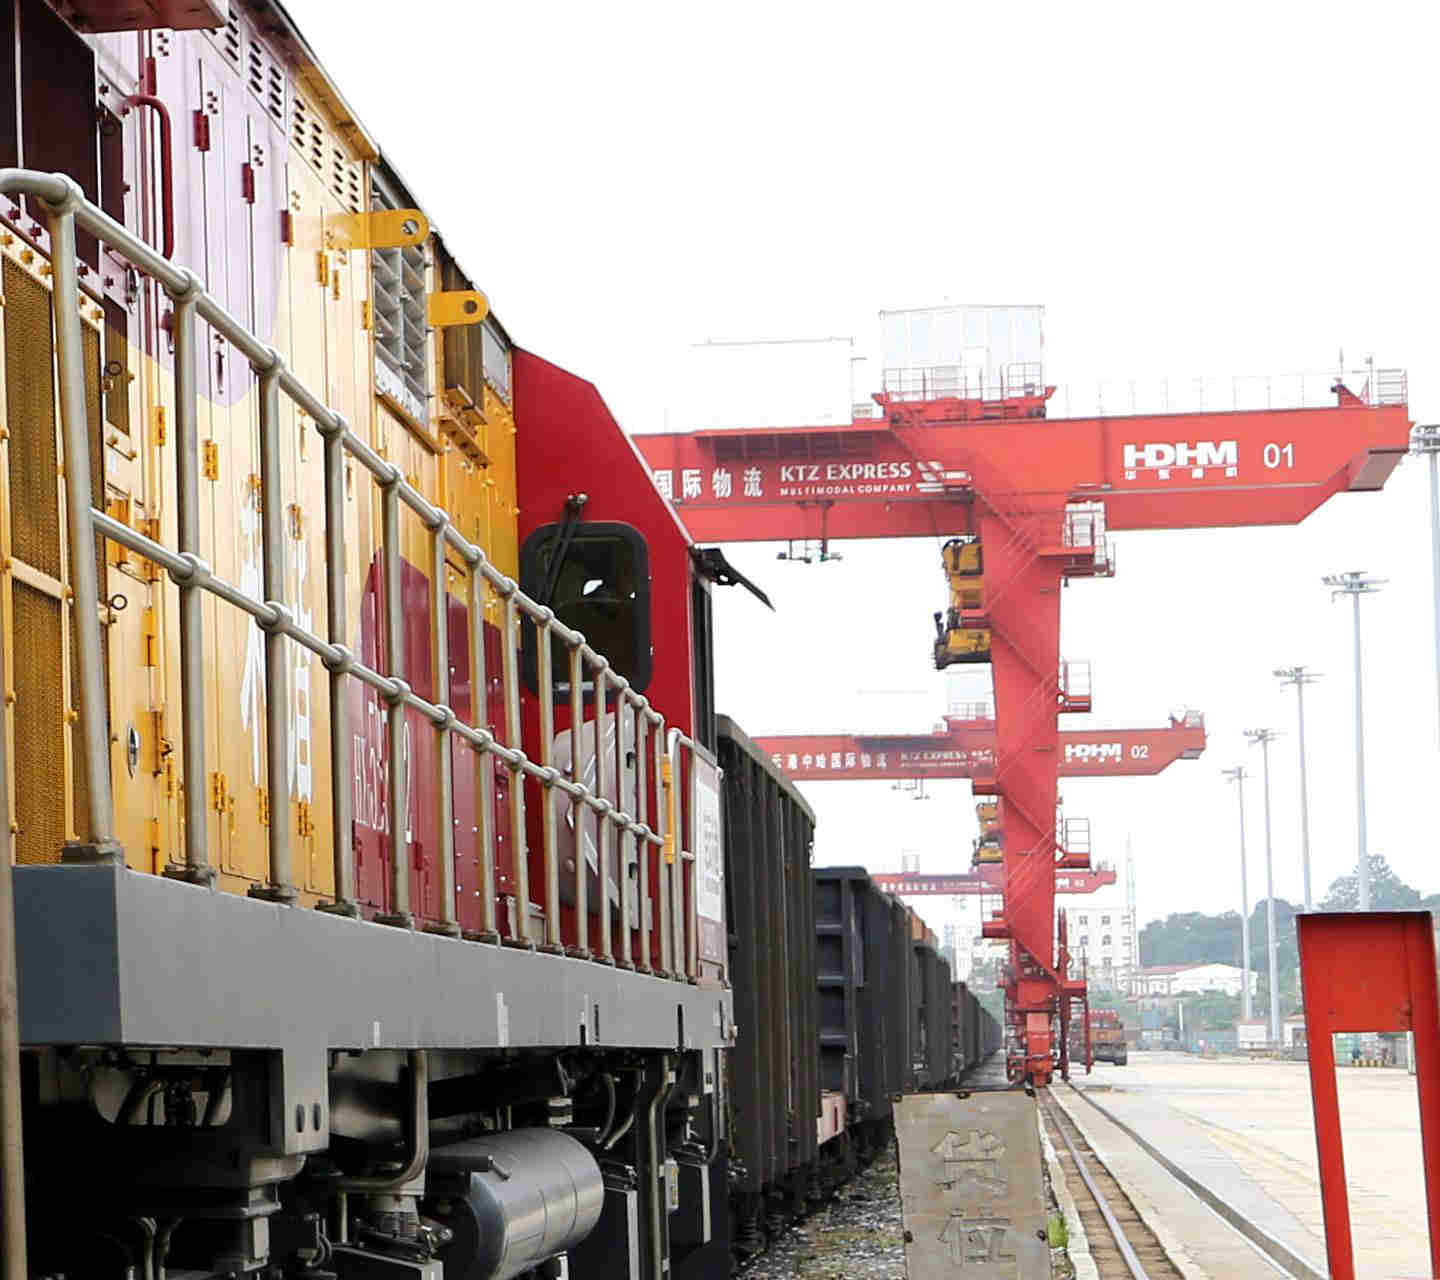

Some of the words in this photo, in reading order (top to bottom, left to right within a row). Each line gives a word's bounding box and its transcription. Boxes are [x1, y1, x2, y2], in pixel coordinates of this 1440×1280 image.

[1263, 442, 1294, 469] 01
[780, 464, 821, 482] KTZ
[826, 462, 912, 480] EXPRESS
[1130, 744, 1149, 759] 02
